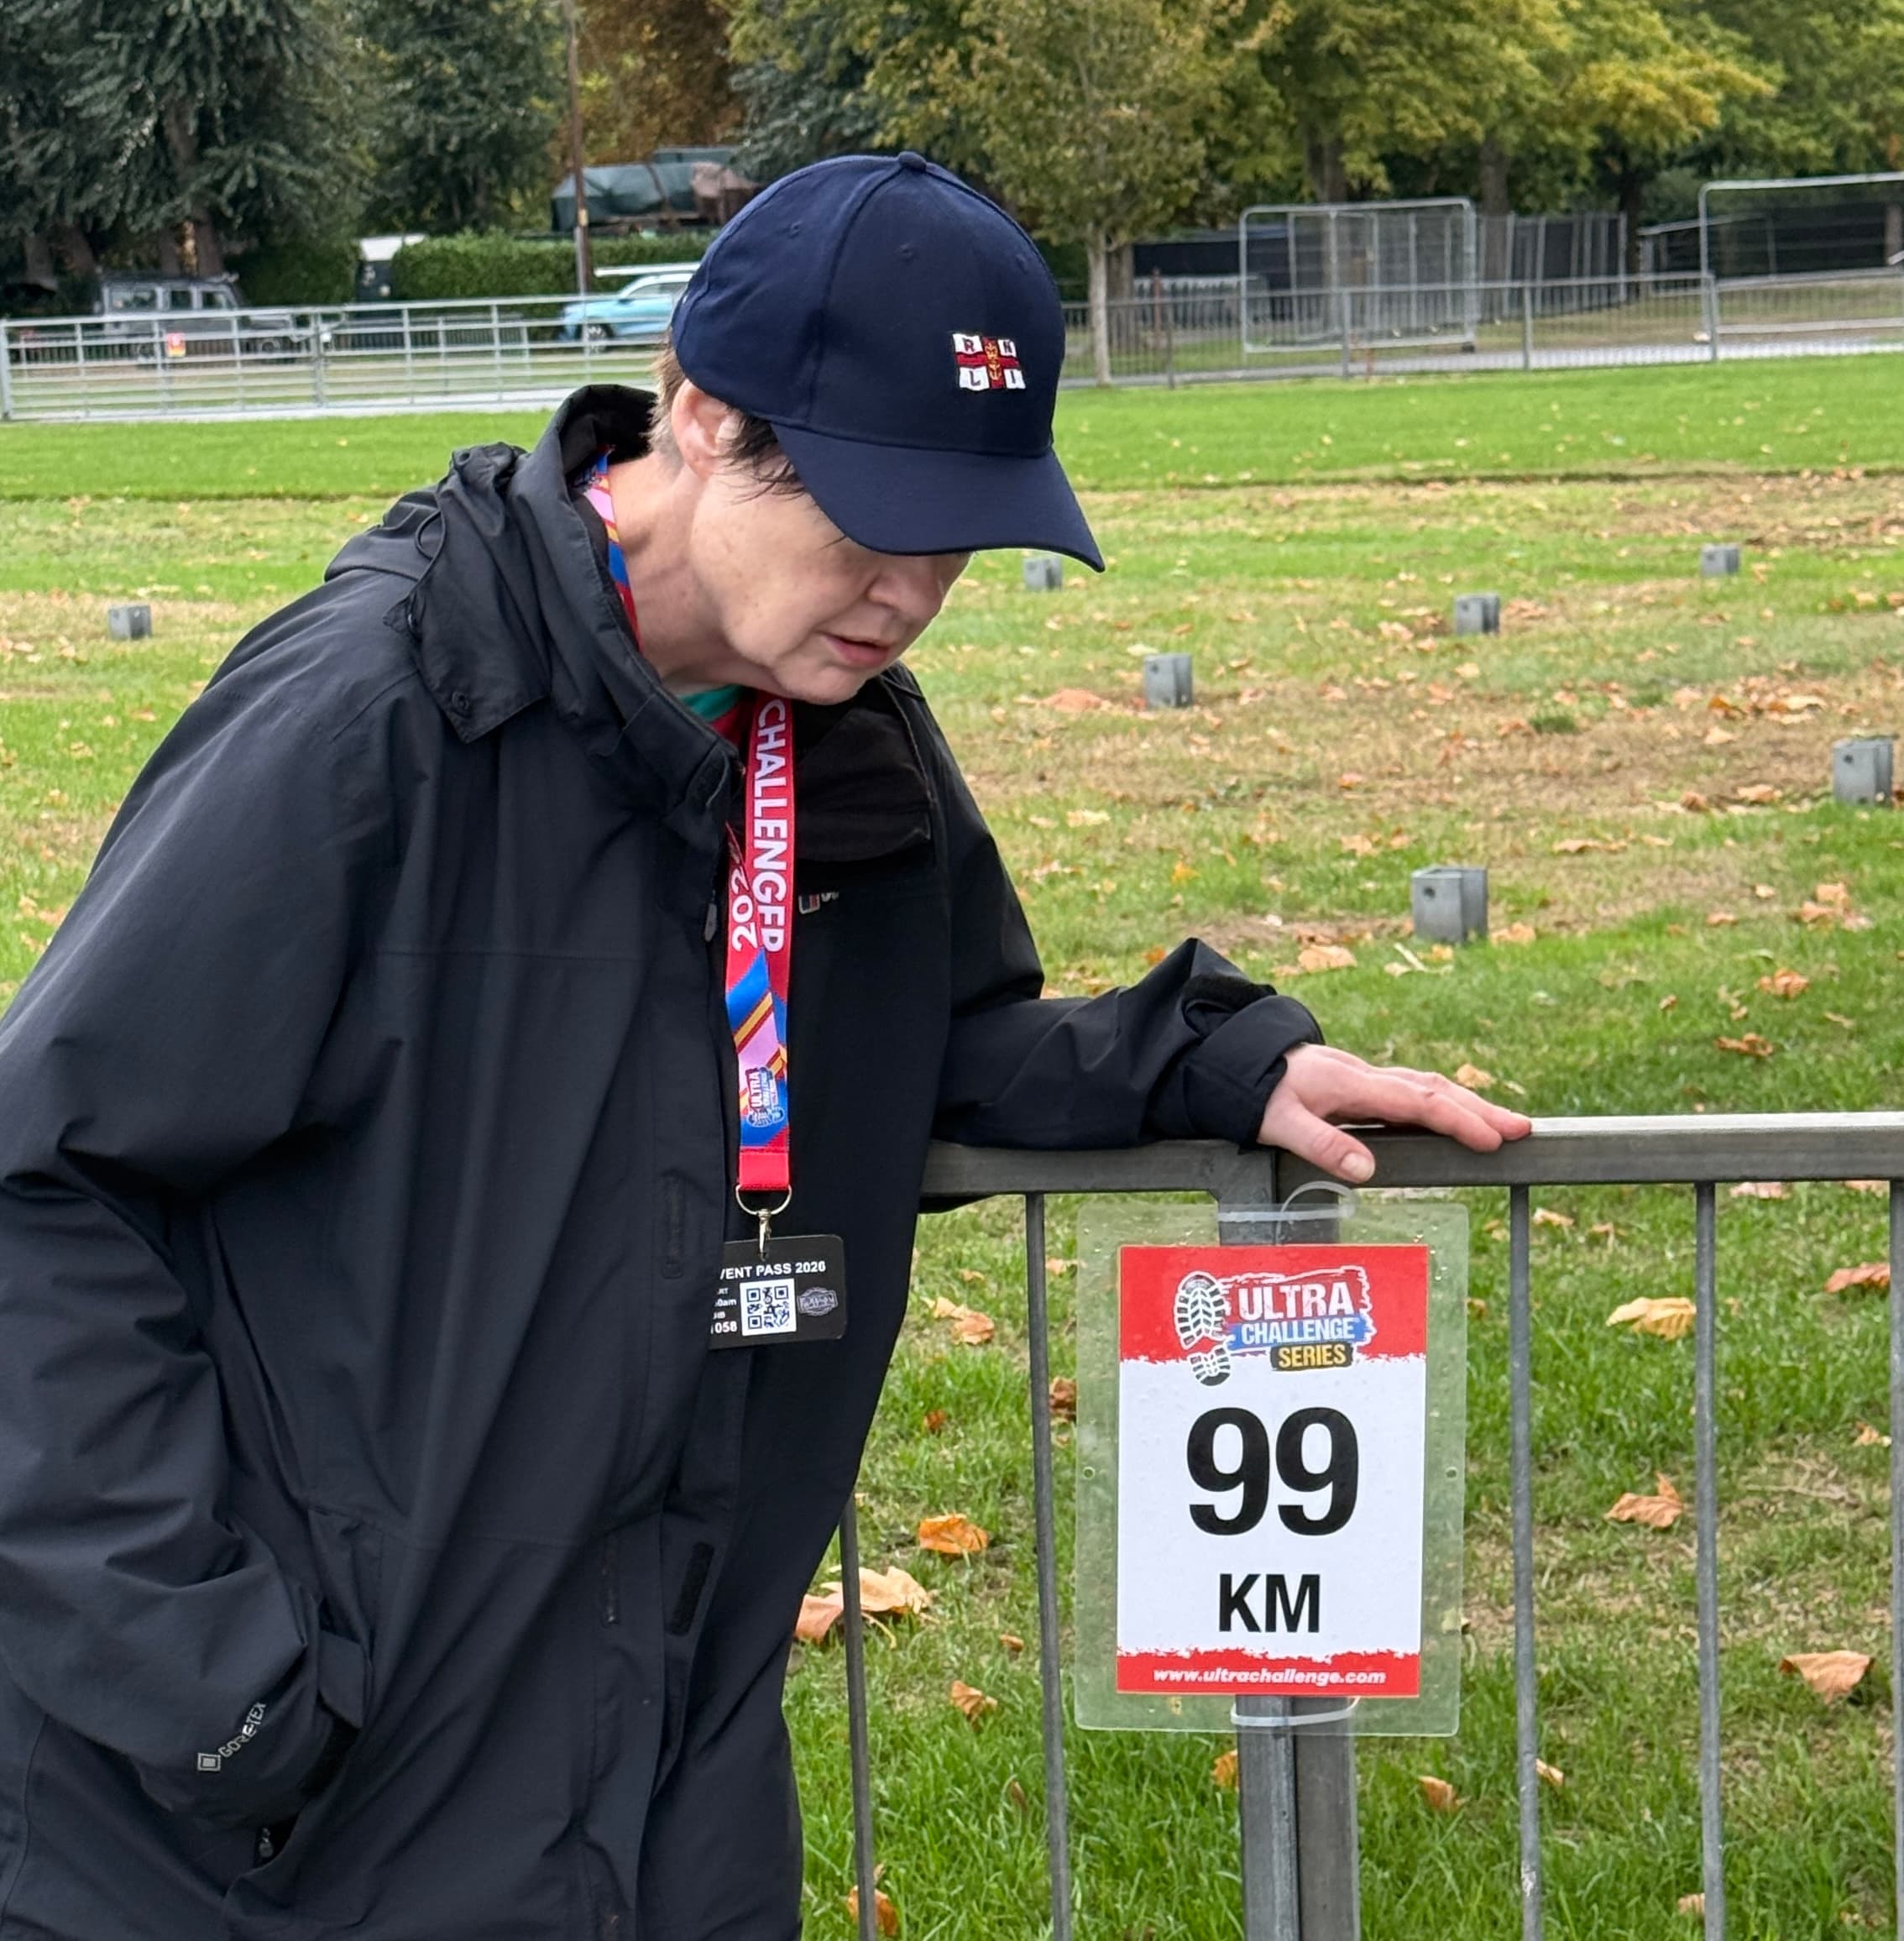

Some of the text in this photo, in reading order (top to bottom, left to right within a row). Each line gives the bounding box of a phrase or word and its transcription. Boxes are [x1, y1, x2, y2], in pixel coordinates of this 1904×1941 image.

[756, 1263, 792, 1276] PASS
[1238, 1282, 1355, 1321] ULTRA
[1242, 1317, 1356, 1345] CHALLENGE
[1279, 1344, 1347, 1368] SERIES
[1186, 1407, 1359, 1536] 99
[1218, 1573, 1321, 1633] KM
[1153, 1668, 1386, 1687] www.ultrachallenge.com
[218, 1702, 267, 1758] GORE-TEX
